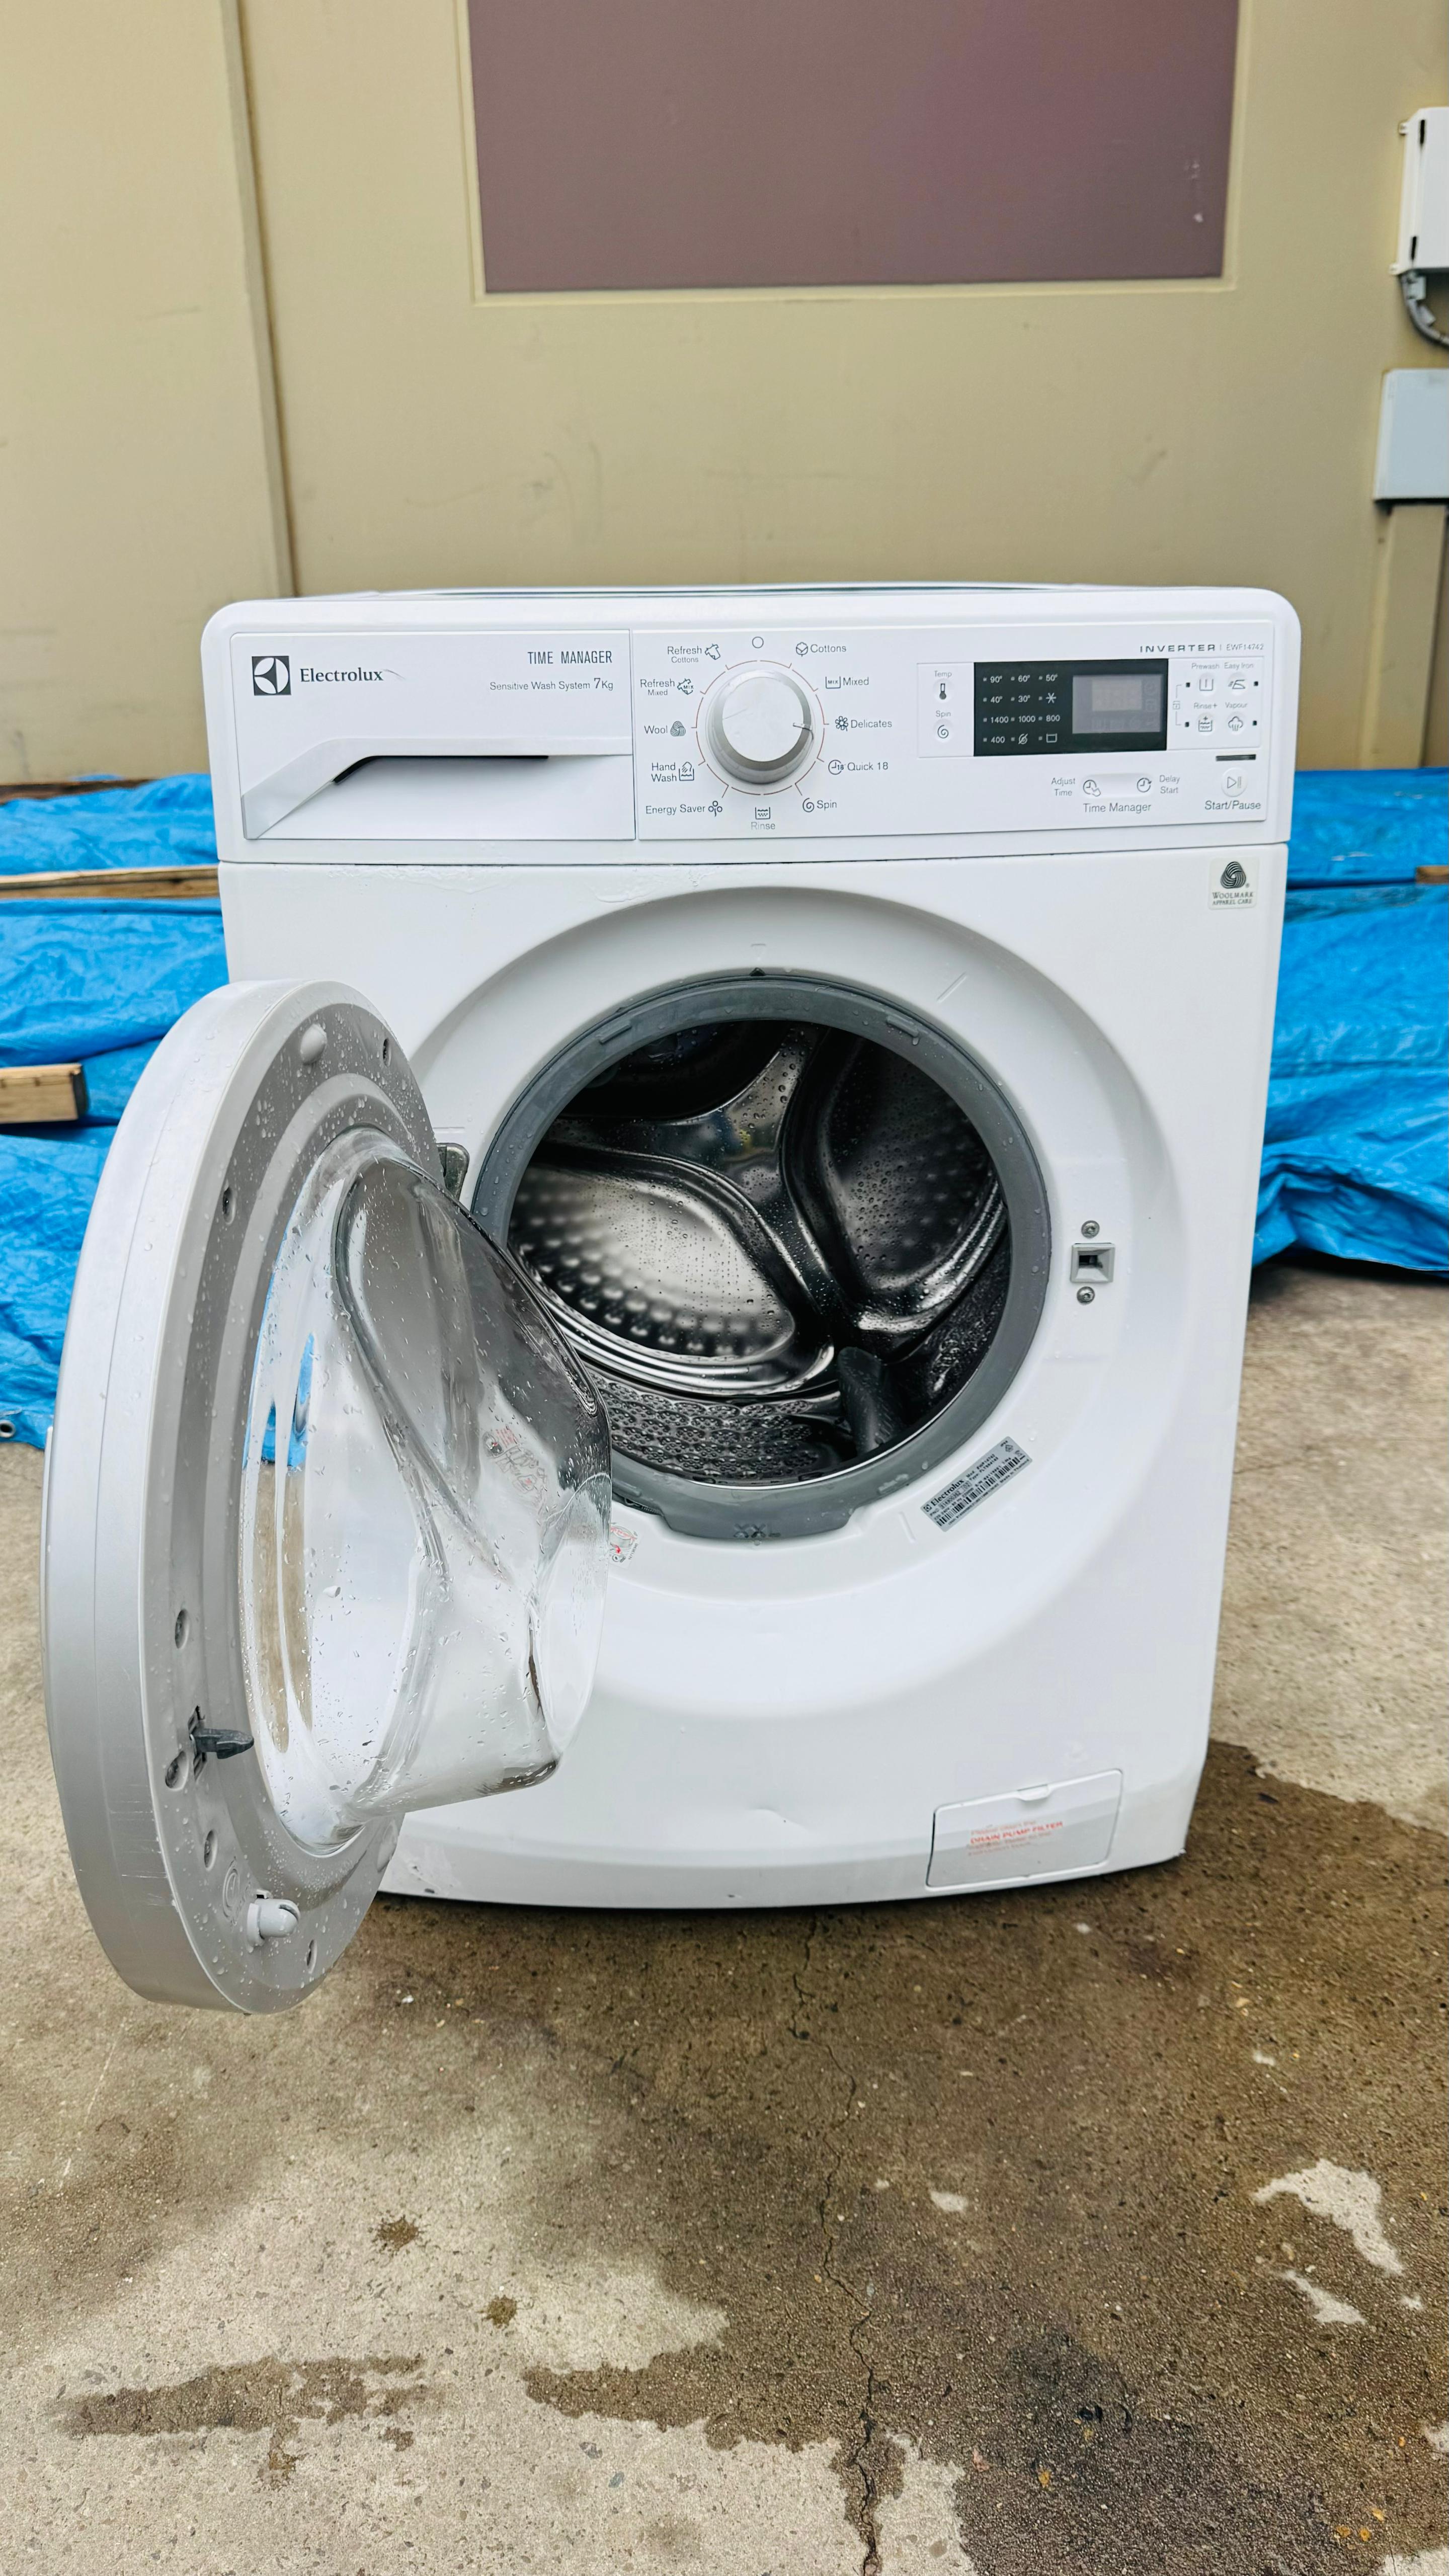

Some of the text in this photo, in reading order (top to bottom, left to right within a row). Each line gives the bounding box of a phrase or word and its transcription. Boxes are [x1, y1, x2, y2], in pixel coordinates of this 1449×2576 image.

[667, 645, 702, 655] Refresh
[810, 643, 847, 653] Cottons
[1140, 644, 1216, 653] INVERTER
[527, 650, 613, 665] TIME MANAGER
[671, 656, 699, 664] Cottons
[1224, 662, 1240, 670] Easy
[300, 667, 384, 683] Electrolux
[934, 670, 952, 679] Temp
[490, 681, 528, 691] Sensitive
[531, 681, 555, 690] Wash
[558, 680, 590, 691] System
[640, 678, 675, 688] Refresh
[843, 677, 869, 686] Mixed
[935, 710, 951, 719] Spin
[1046, 714, 1060, 722] 800
[851, 719, 893, 728] Delicates
[990, 716, 1009, 724] 1400
[644, 725, 668, 735] Wool
[652, 762, 676, 772] Hand
[847, 762, 888, 771] Quick 18
[651, 772, 677, 782] Wash
[1051, 777, 1076, 787] Adjust
[1159, 774, 1180, 785] Delay
[1054, 788, 1073, 796] Time
[1160, 785, 1179, 795] Start
[817, 799, 837, 810] Spin
[1083, 802, 1151, 815] Time Manager
[1204, 800, 1261, 811] Start/Pause
[646, 804, 705, 816] Energy Saver
[751, 821, 775, 831] Rinse
[930, 1477, 964, 1506] Electrolux
